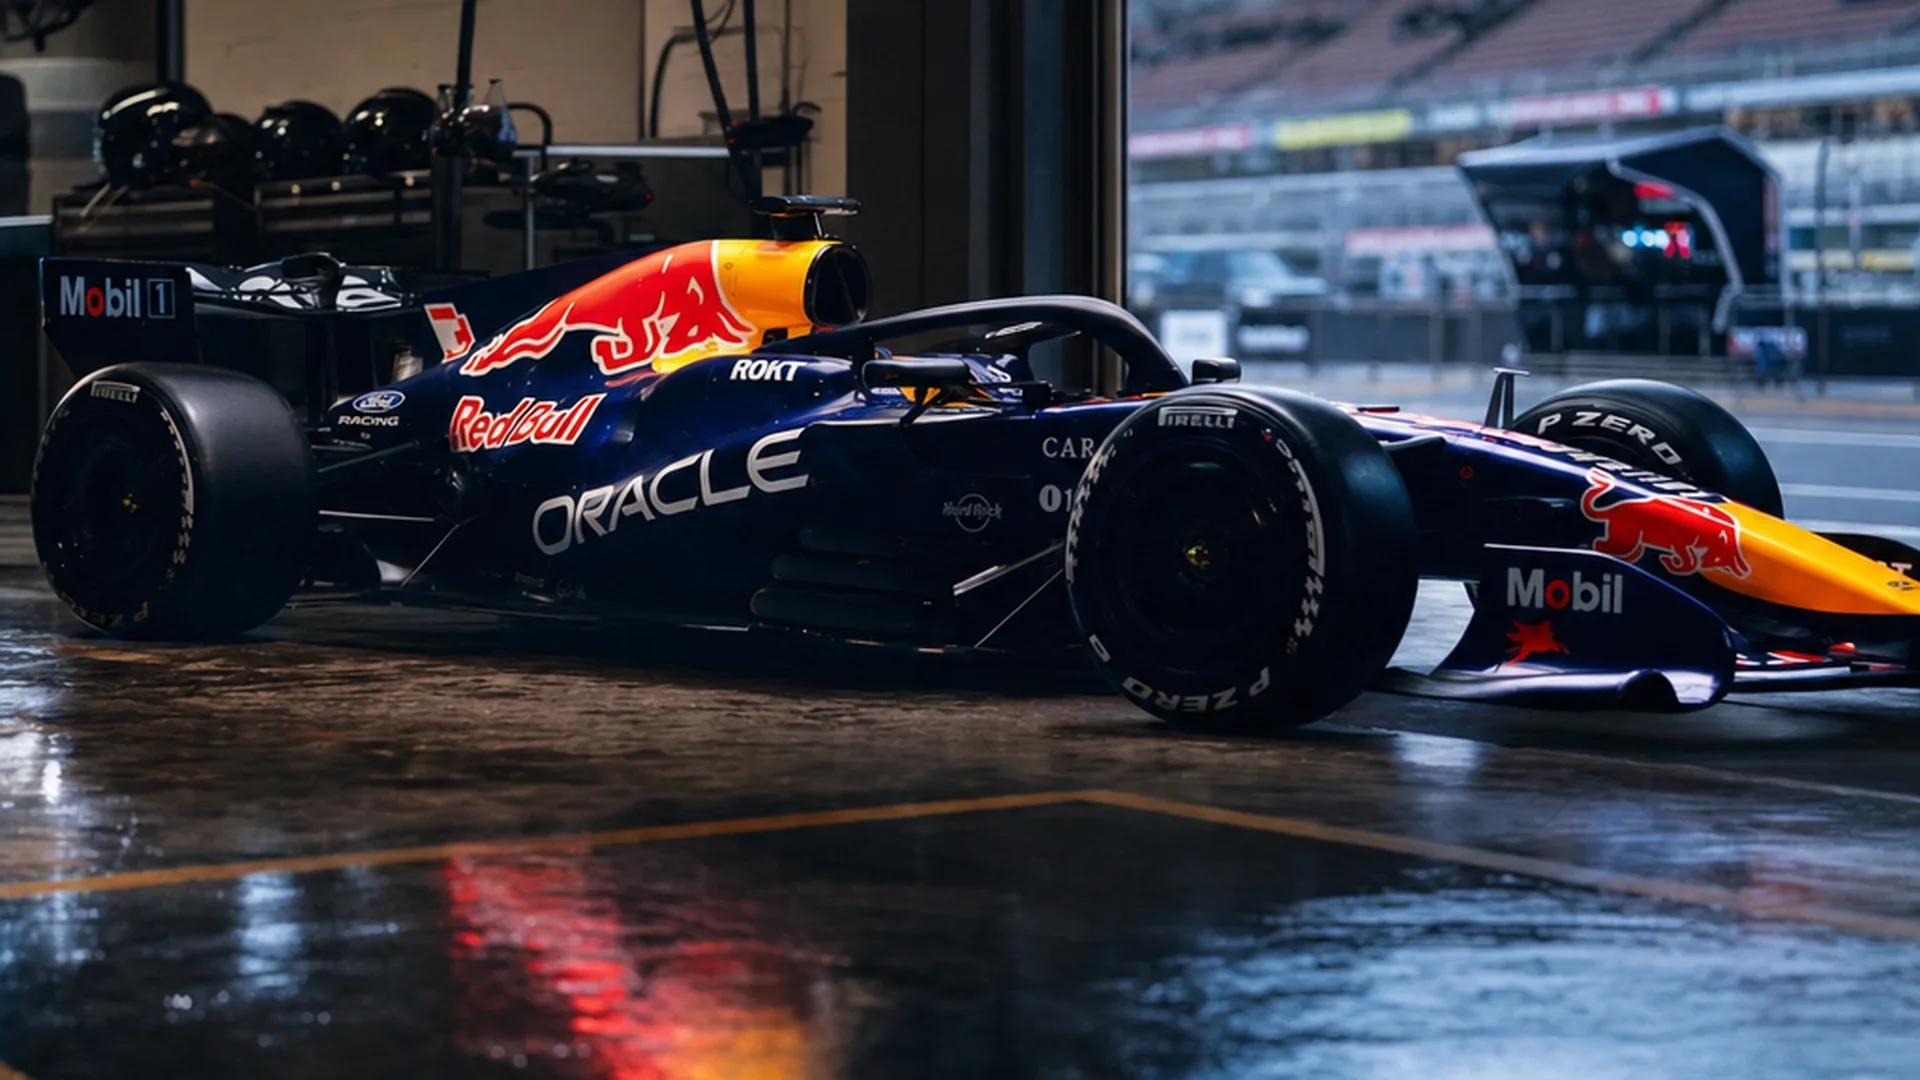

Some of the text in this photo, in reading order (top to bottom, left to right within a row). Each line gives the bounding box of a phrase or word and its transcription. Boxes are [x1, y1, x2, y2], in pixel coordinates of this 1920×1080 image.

[60, 275, 141, 318] Mobil
[152, 280, 169, 316] 1
[729, 359, 808, 382] ROKT
[337, 415, 400, 427] RACING
[448, 392, 608, 452] Red Bull
[1158, 406, 1238, 429] PIRELLI
[1537, 413, 1562, 435] P
[1572, 411, 1683, 465] ZERO
[532, 427, 811, 556] ORACLE
[1506, 566, 1624, 614] Mobil
[1121, 666, 1270, 713] P ZERO
